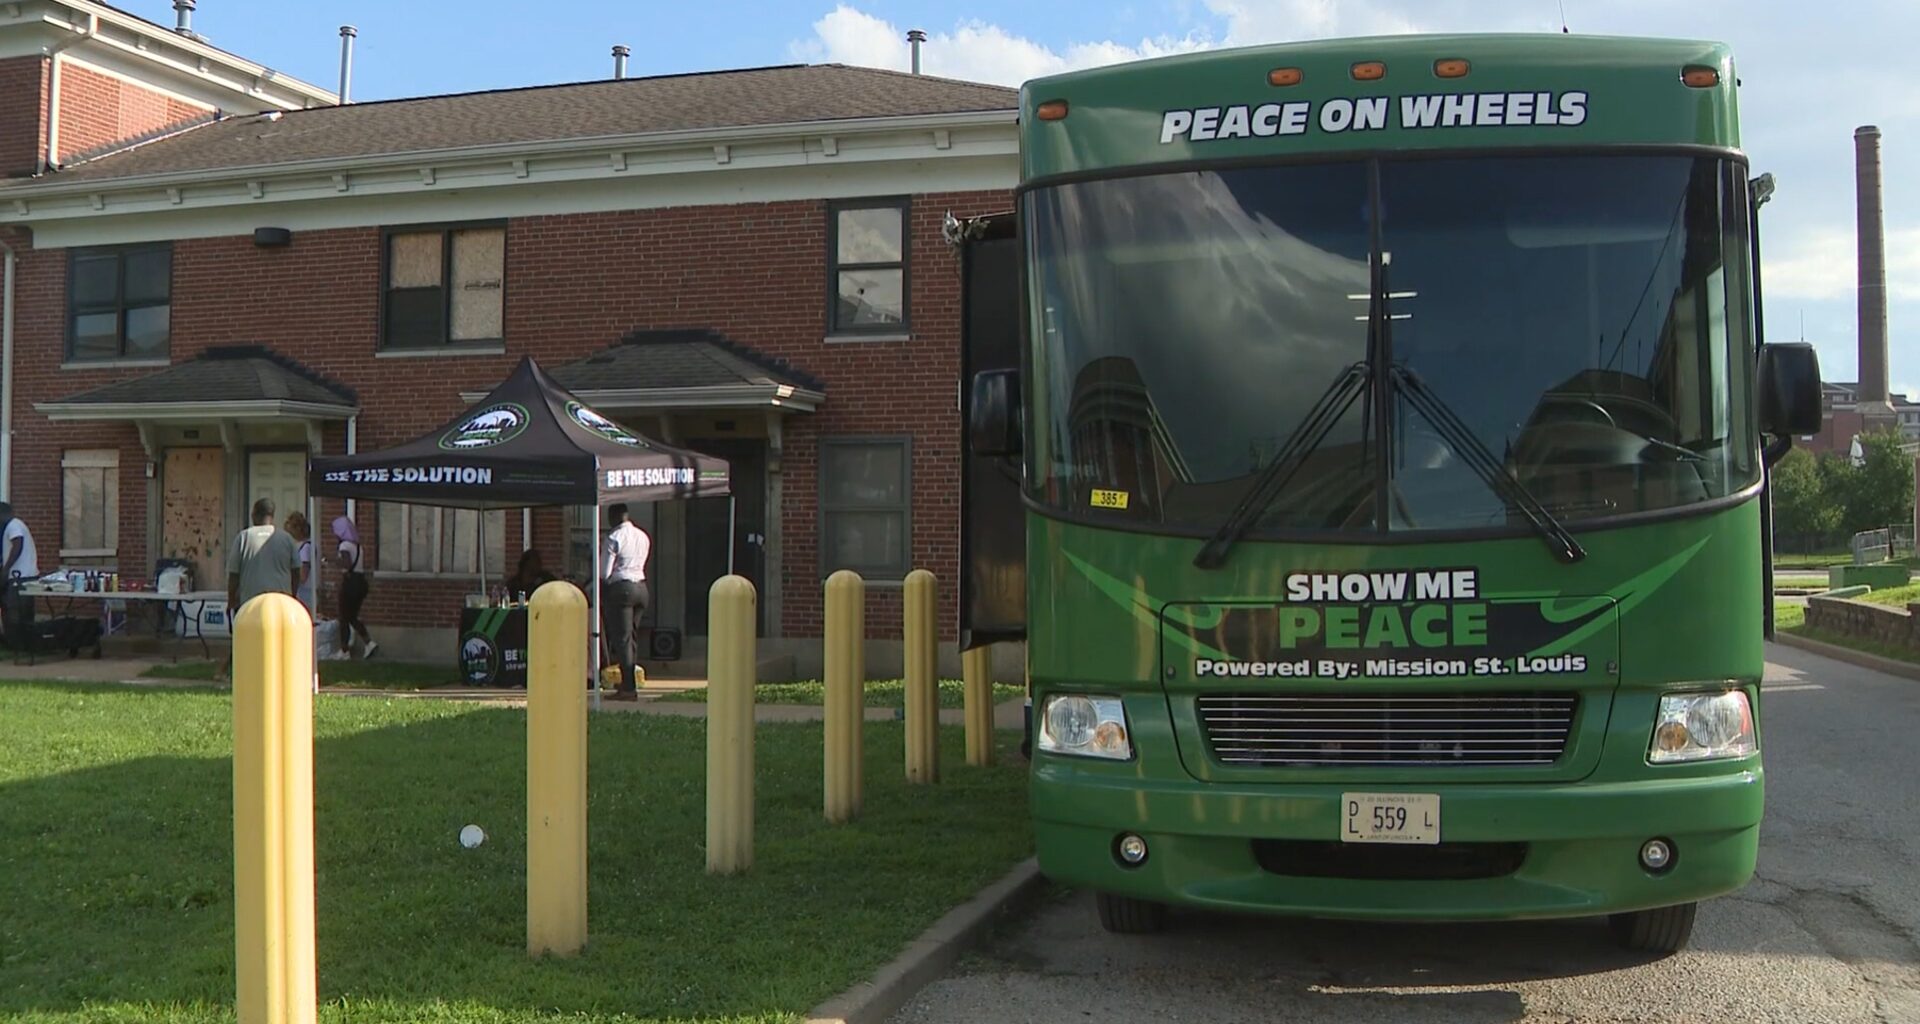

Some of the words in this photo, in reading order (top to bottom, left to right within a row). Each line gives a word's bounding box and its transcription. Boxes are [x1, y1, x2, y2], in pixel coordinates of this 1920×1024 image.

[1159, 102, 1309, 143] PEACE
[1319, 97, 1389, 133] ON
[1400, 92, 1588, 128] WHEELS
[352, 468, 389, 482] THE
[392, 466, 492, 484] SOLUTION
[607, 471, 623, 487] BE
[623, 470, 645, 487] THE
[645, 468, 694, 486] SOLUTION
[1101, 492, 1118, 506] 385
[1286, 572, 1409, 601] SHOW
[1415, 569, 1476, 600] ME
[1279, 603, 1488, 649] PEACE
[504, 649, 518, 661] BE
[1196, 658, 1311, 677] Powered
[1317, 658, 1359, 680] By:
[1366, 657, 1467, 677] Mission
[1474, 656, 1510, 675] St.
[1517, 653, 1587, 674] Louis
[1374, 806, 1407, 831] 559
[1424, 811, 1433, 827] L
